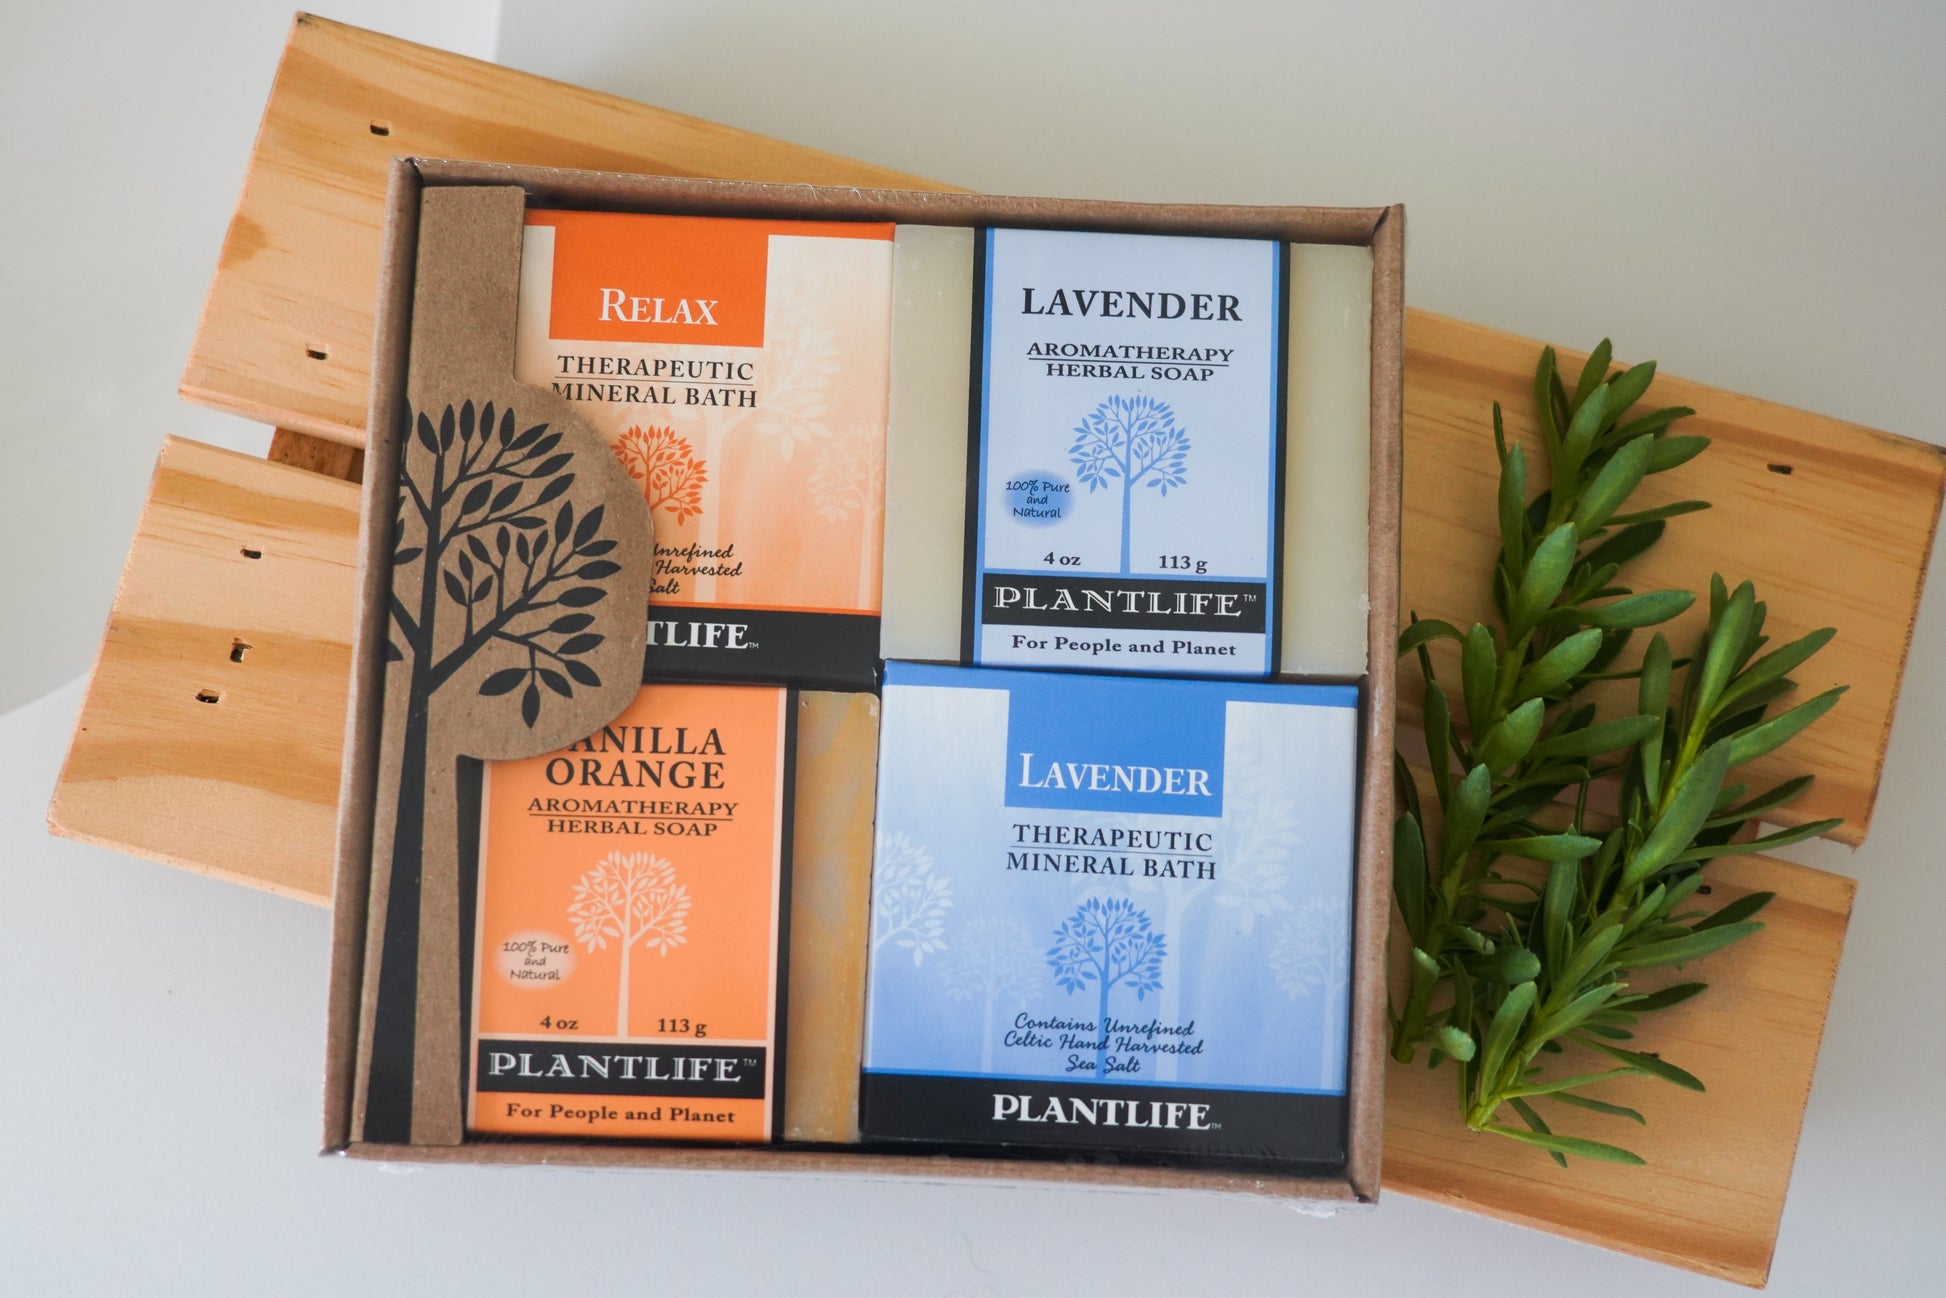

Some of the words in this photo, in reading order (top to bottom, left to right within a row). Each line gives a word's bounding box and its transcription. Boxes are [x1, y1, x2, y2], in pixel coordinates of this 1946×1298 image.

[1021, 287, 1243, 321] LAVENDER
[1026, 342, 1234, 361] AROMATHERAPY
[557, 355, 754, 380] THERAPEUTIC
[1046, 363, 1145, 379] HERBAL
[1151, 367, 1214, 381] SOAP
[552, 382, 676, 404] MINERAL
[685, 387, 758, 408] BATH
[1005, 479, 1039, 495] 100%
[1042, 481, 1070, 493] Pure
[1026, 494, 1048, 505] and
[1013, 507, 1062, 518] Natural
[1043, 551, 1055, 565] 4
[1059, 555, 1081, 566] oz
[1159, 555, 1191, 569] 113
[1195, 560, 1207, 574] g
[656, 560, 743, 577] Harvested
[1011, 635, 1048, 650] For
[1054, 636, 1122, 655] People
[1129, 640, 1164, 653] and
[1172, 640, 1236, 656] Planet
[567, 725, 726, 755] ANILLA
[546, 757, 725, 789] ORANGE
[527, 798, 739, 816] AROMATHERAPY
[547, 819, 647, 835] HERBAL
[653, 822, 718, 837] SOAP
[1012, 824, 1212, 851] THERAPEUTIC
[1006, 852, 1134, 876] MINERAL
[1143, 858, 1216, 880] BATH
[503, 940, 537, 957] 100%
[540, 942, 569, 954] Pure
[524, 956, 546, 966] and
[510, 969, 560, 981] Natural
[539, 1015, 552, 1029] 4
[556, 1018, 579, 1030] oz
[657, 1018, 690, 1033] 113
[695, 1023, 707, 1037] g
[1014, 1012, 1097, 1032] Contains
[1104, 1017, 1195, 1038] Unrefined
[1004, 1030, 1053, 1048] Celtic
[1058, 1033, 1109, 1051] Hand
[1115, 1036, 1204, 1055] Harvested
[1065, 1054, 1098, 1072] Sea
[1103, 1056, 1141, 1074] Salt
[506, 1103, 543, 1118] For
[549, 1104, 618, 1123] People
[625, 1108, 662, 1121] and
[669, 1107, 736, 1123] Planet
